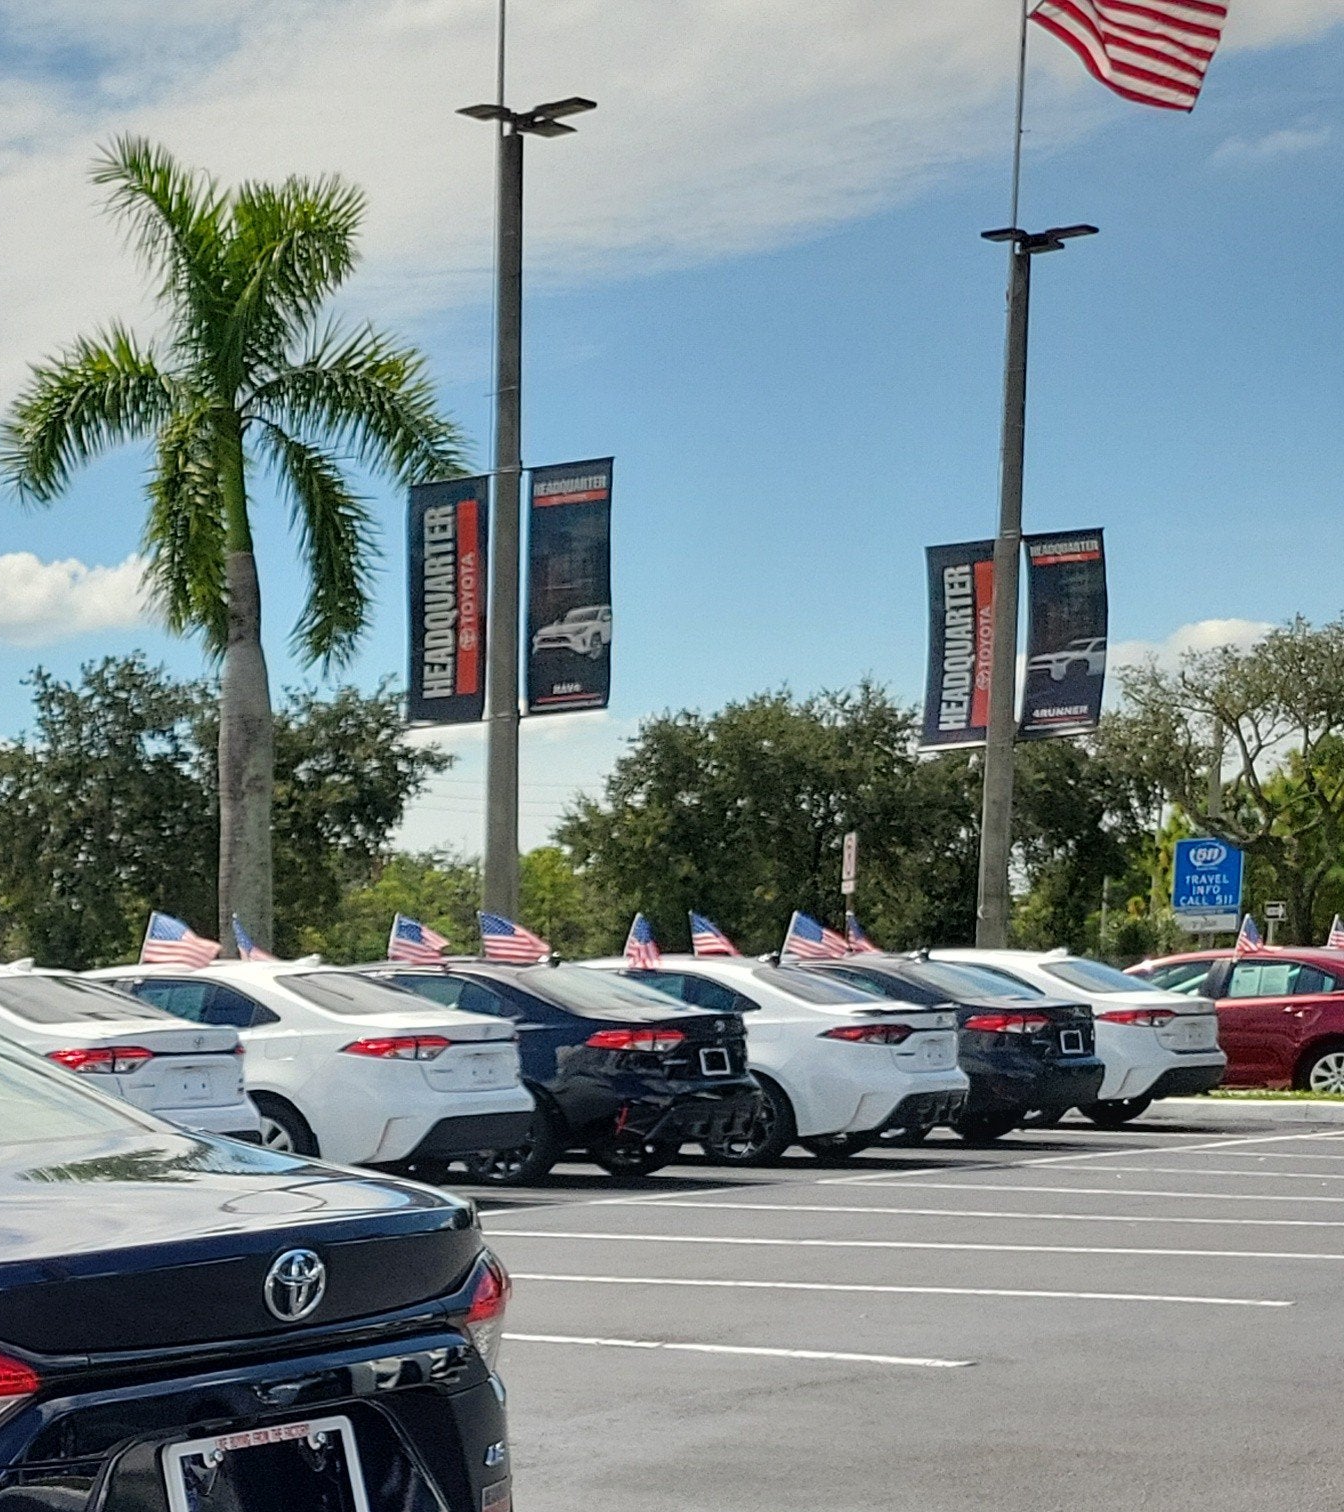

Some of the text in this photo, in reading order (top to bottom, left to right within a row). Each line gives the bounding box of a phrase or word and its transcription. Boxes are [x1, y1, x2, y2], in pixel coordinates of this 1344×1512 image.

[460, 552, 477, 625] TOYOTA
[423, 504, 458, 699] HEADQUARTER
[939, 564, 974, 731] HEADQUARTER
[1032, 705, 1088, 718] 4RUNNER
[1186, 874, 1229, 885] TRAVEL
[1192, 885, 1221, 895] INFO
[1180, 895, 1233, 906] CALL 511
